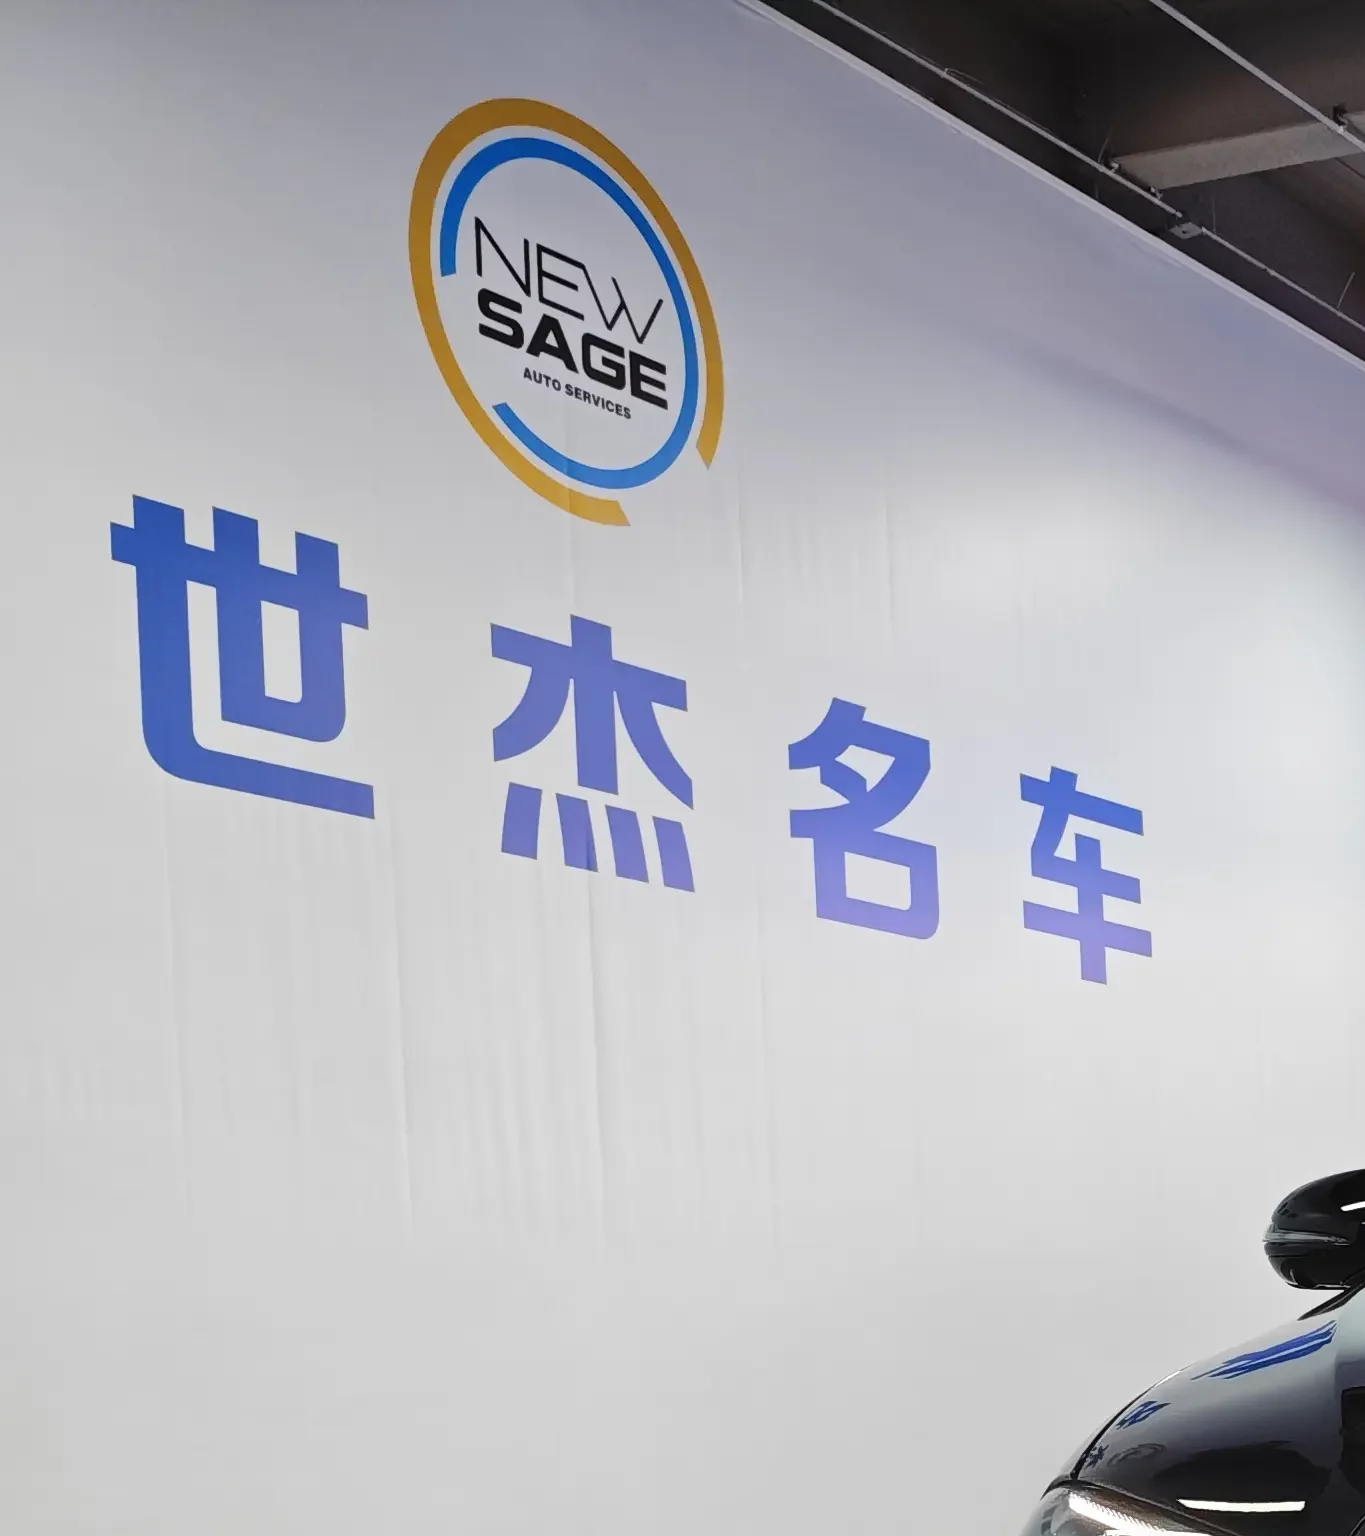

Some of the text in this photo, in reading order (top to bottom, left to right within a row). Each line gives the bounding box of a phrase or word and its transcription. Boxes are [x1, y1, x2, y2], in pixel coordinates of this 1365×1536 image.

[474, 216, 664, 345] NEW
[477, 287, 669, 411] SAGE
[522, 366, 632, 420] AUTO SERVICES
[110, 493, 1153, 986] 世杰名车
